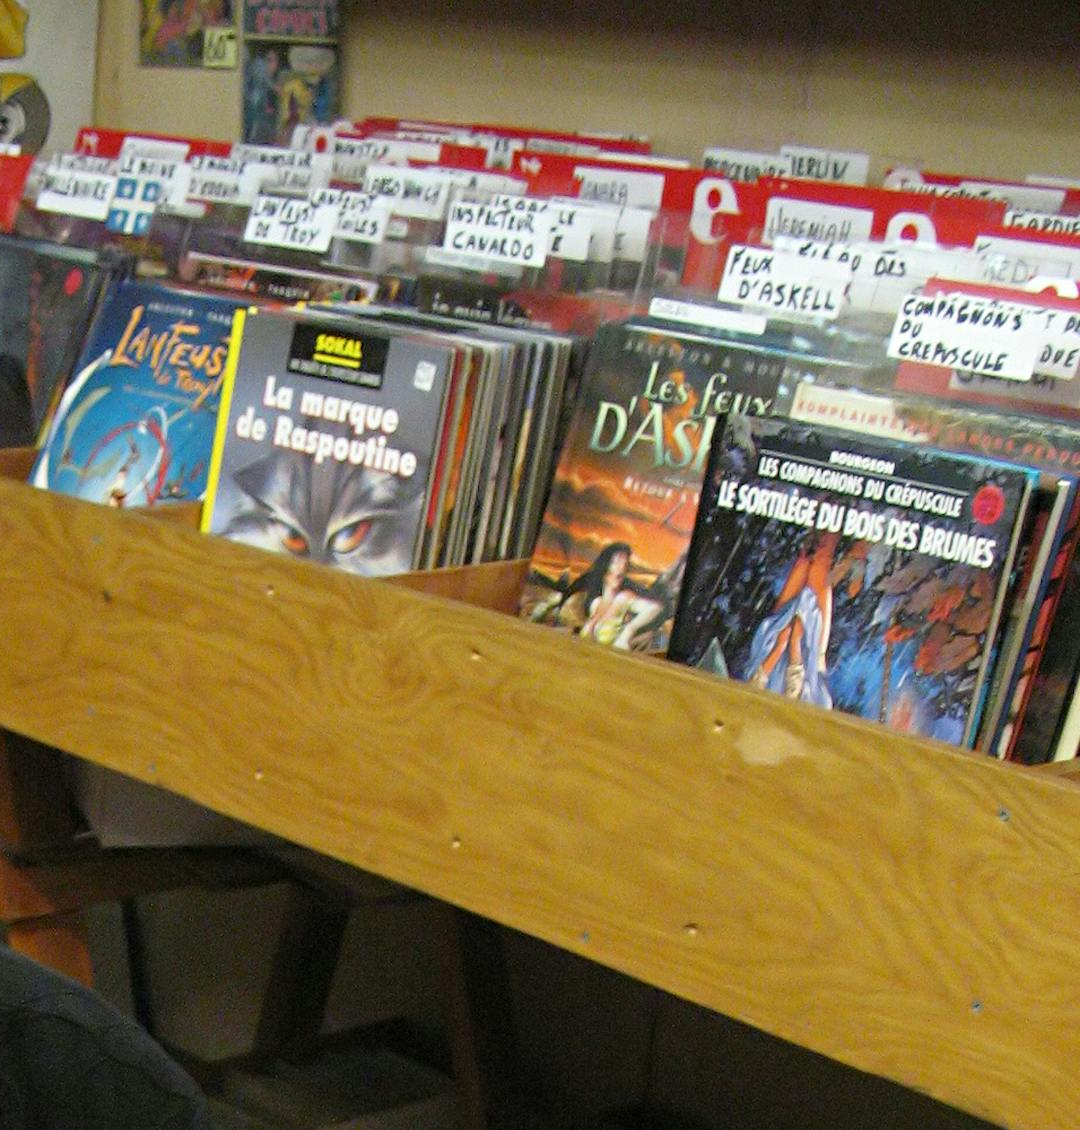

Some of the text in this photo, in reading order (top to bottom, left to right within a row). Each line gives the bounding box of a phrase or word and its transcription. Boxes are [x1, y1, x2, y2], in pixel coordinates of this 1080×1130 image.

[452, 230, 534, 260] CANARDO
[729, 248, 774, 275] FEUX
[738, 280, 835, 312] D'ASKELL
[900, 320, 923, 338] DU
[903, 298, 1023, 331] COMPAGNONS
[314, 333, 364, 359] SOKAL
[898, 341, 1008, 372] CREPUSCULE
[263, 375, 400, 435] La marque
[235, 406, 417, 478] de Raspoutine
[829, 450, 896, 475] BOURGEON
[757, 455, 965, 519] LES COMPAGNONS DU CRÉPUSCULE
[717, 479, 997, 570] LE SORTILÈGE DU BOIS DES BRUMES
